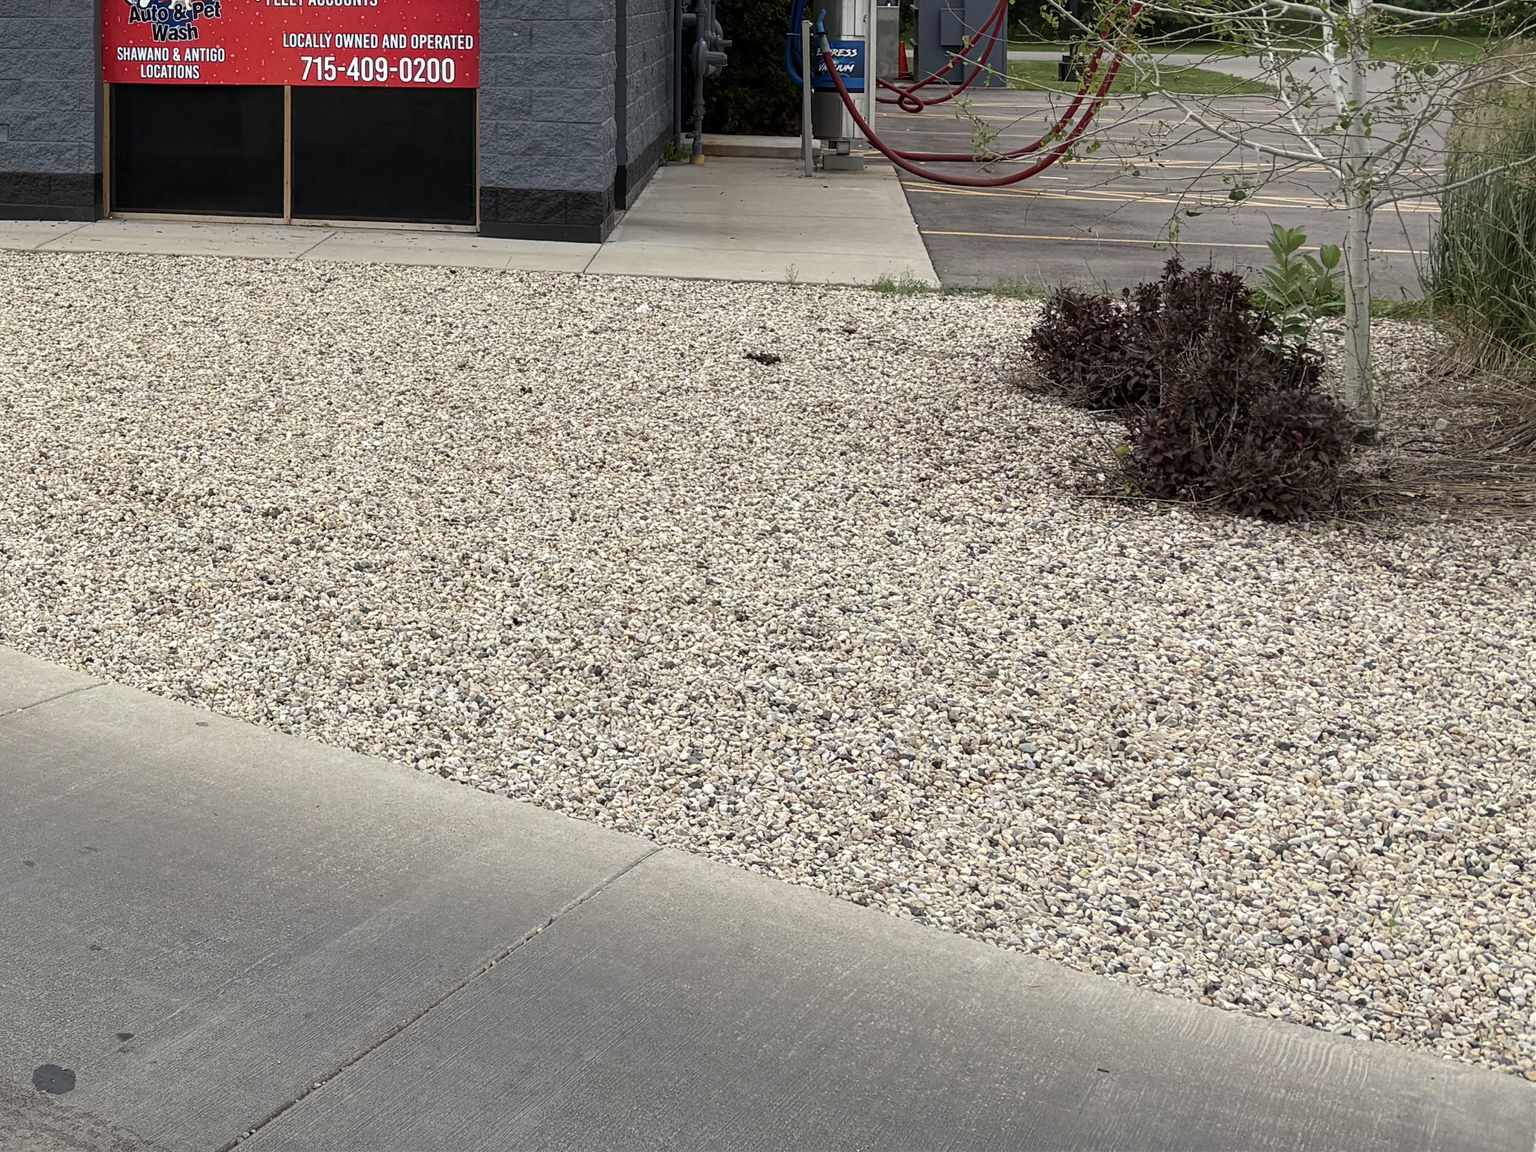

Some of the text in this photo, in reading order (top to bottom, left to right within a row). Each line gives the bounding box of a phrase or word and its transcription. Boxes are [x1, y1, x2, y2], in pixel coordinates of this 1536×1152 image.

[128, 0, 222, 24] Auto & Pet
[152, 22, 199, 42] Wash
[282, 33, 474, 50] LOCALLY OWNED AND OPERATED
[117, 47, 226, 62] SHAWANO & ANTIGO
[140, 64, 200, 79] LOCATIONS
[300, 56, 456, 83] 715-409-0200
